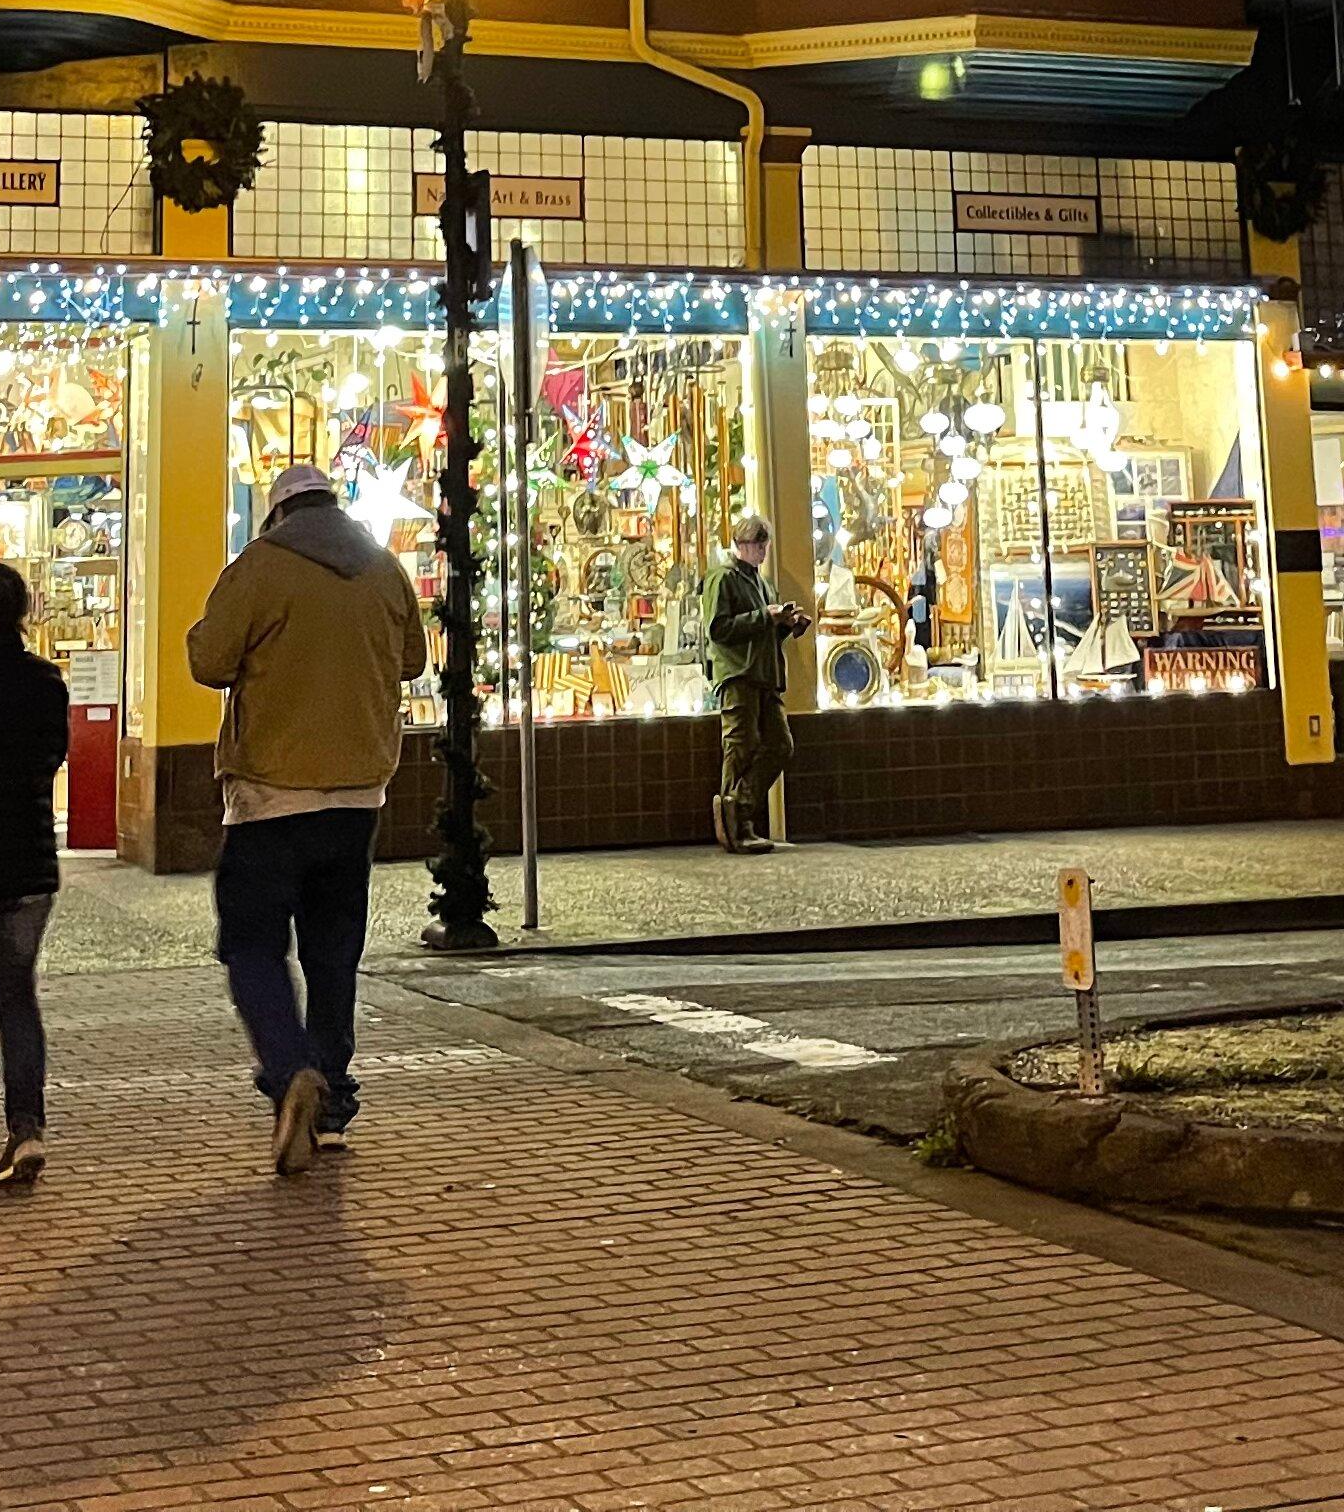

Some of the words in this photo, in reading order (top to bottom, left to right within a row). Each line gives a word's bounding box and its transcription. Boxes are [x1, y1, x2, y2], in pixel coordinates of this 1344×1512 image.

[492, 190, 513, 205] Art
[520, 191, 530, 206] &
[535, 191, 572, 207] Brass
[966, 205, 1040, 222] Collectibles
[1044, 207, 1054, 222] &
[1058, 208, 1089, 224] Gifts
[1154, 651, 1255, 670] WARNING
